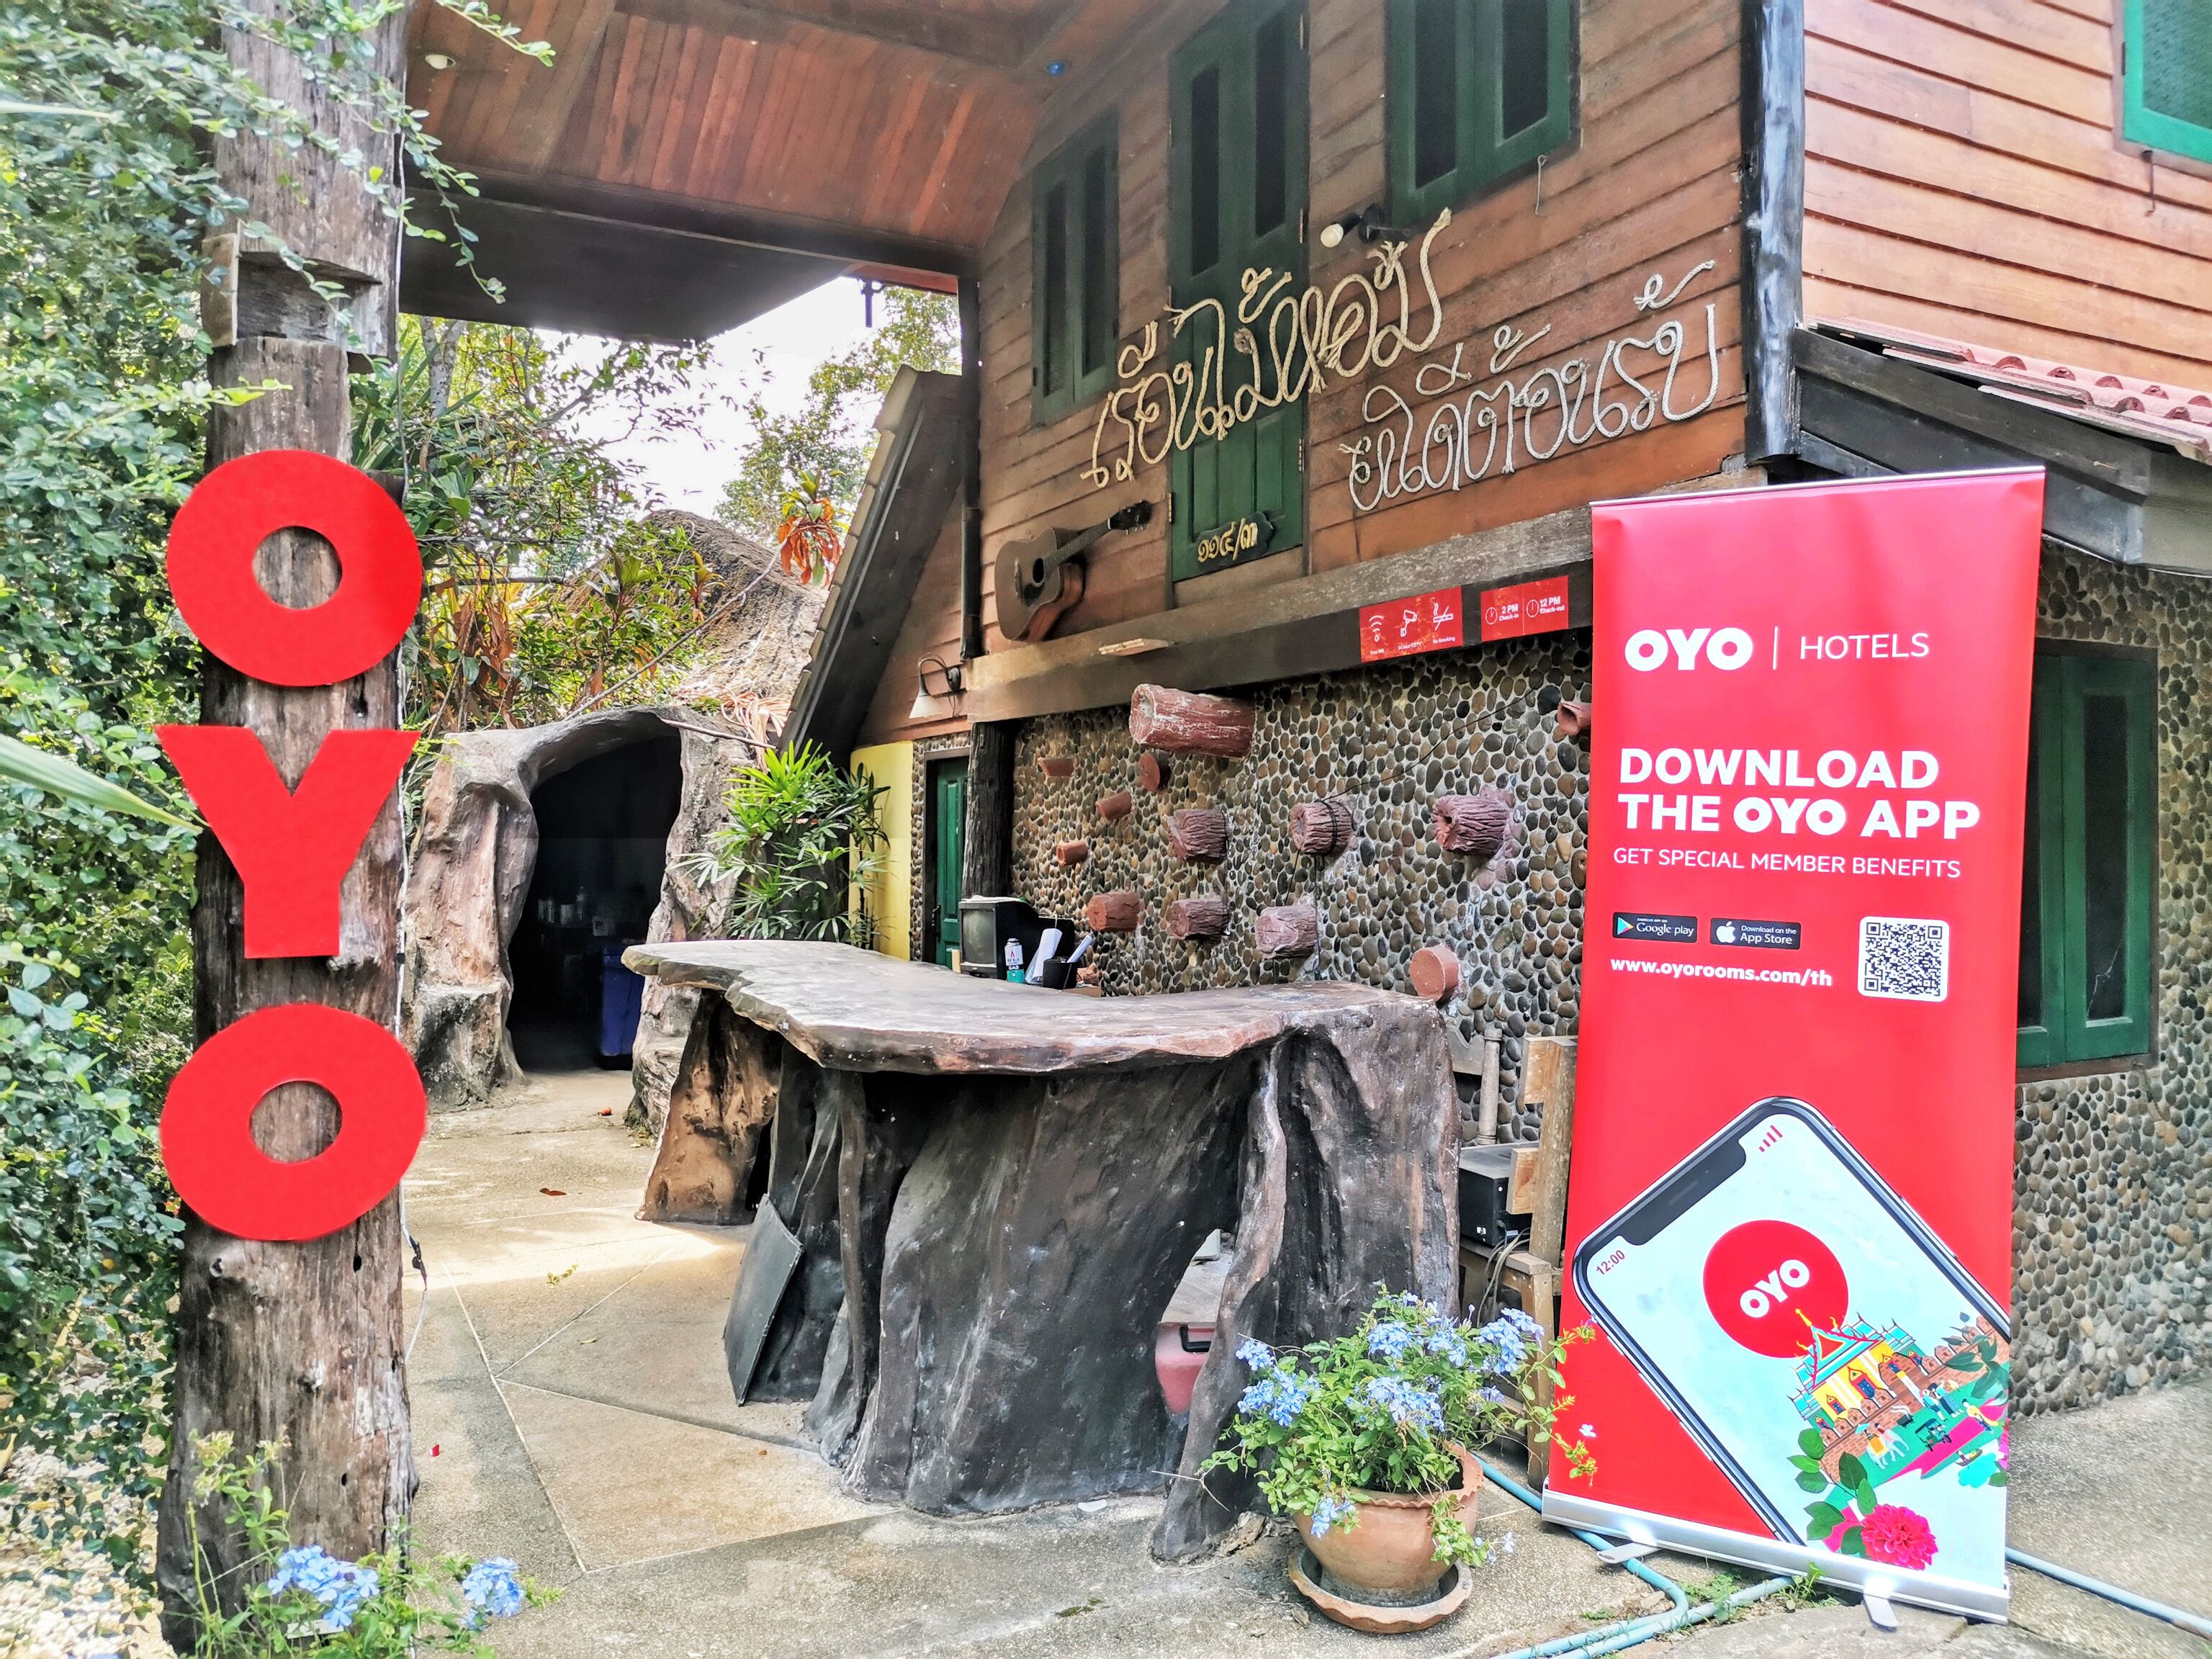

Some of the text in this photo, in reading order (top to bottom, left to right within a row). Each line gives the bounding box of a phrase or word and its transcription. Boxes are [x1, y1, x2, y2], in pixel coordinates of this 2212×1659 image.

[1507, 603, 1519, 613] PM
[1539, 596, 1561, 607] 12 PM
[1624, 627, 1930, 671] OYO HOTELS
[1619, 747, 1939, 789] DOWNLOAD
[1618, 793, 1980, 840] THE OYO APP
[1614, 848, 1961, 878] GET SPECIAL MEMBER BENEFITS
[1636, 922, 1694, 937] Google play
[1740, 934, 1792, 945] App Store
[1741, 925, 1774, 934] Download
[1611, 958, 1833, 986] www.oyorooms.com/th
[1596, 1249, 1626, 1276] 12:00
[1740, 1259, 1810, 1318] OYO
